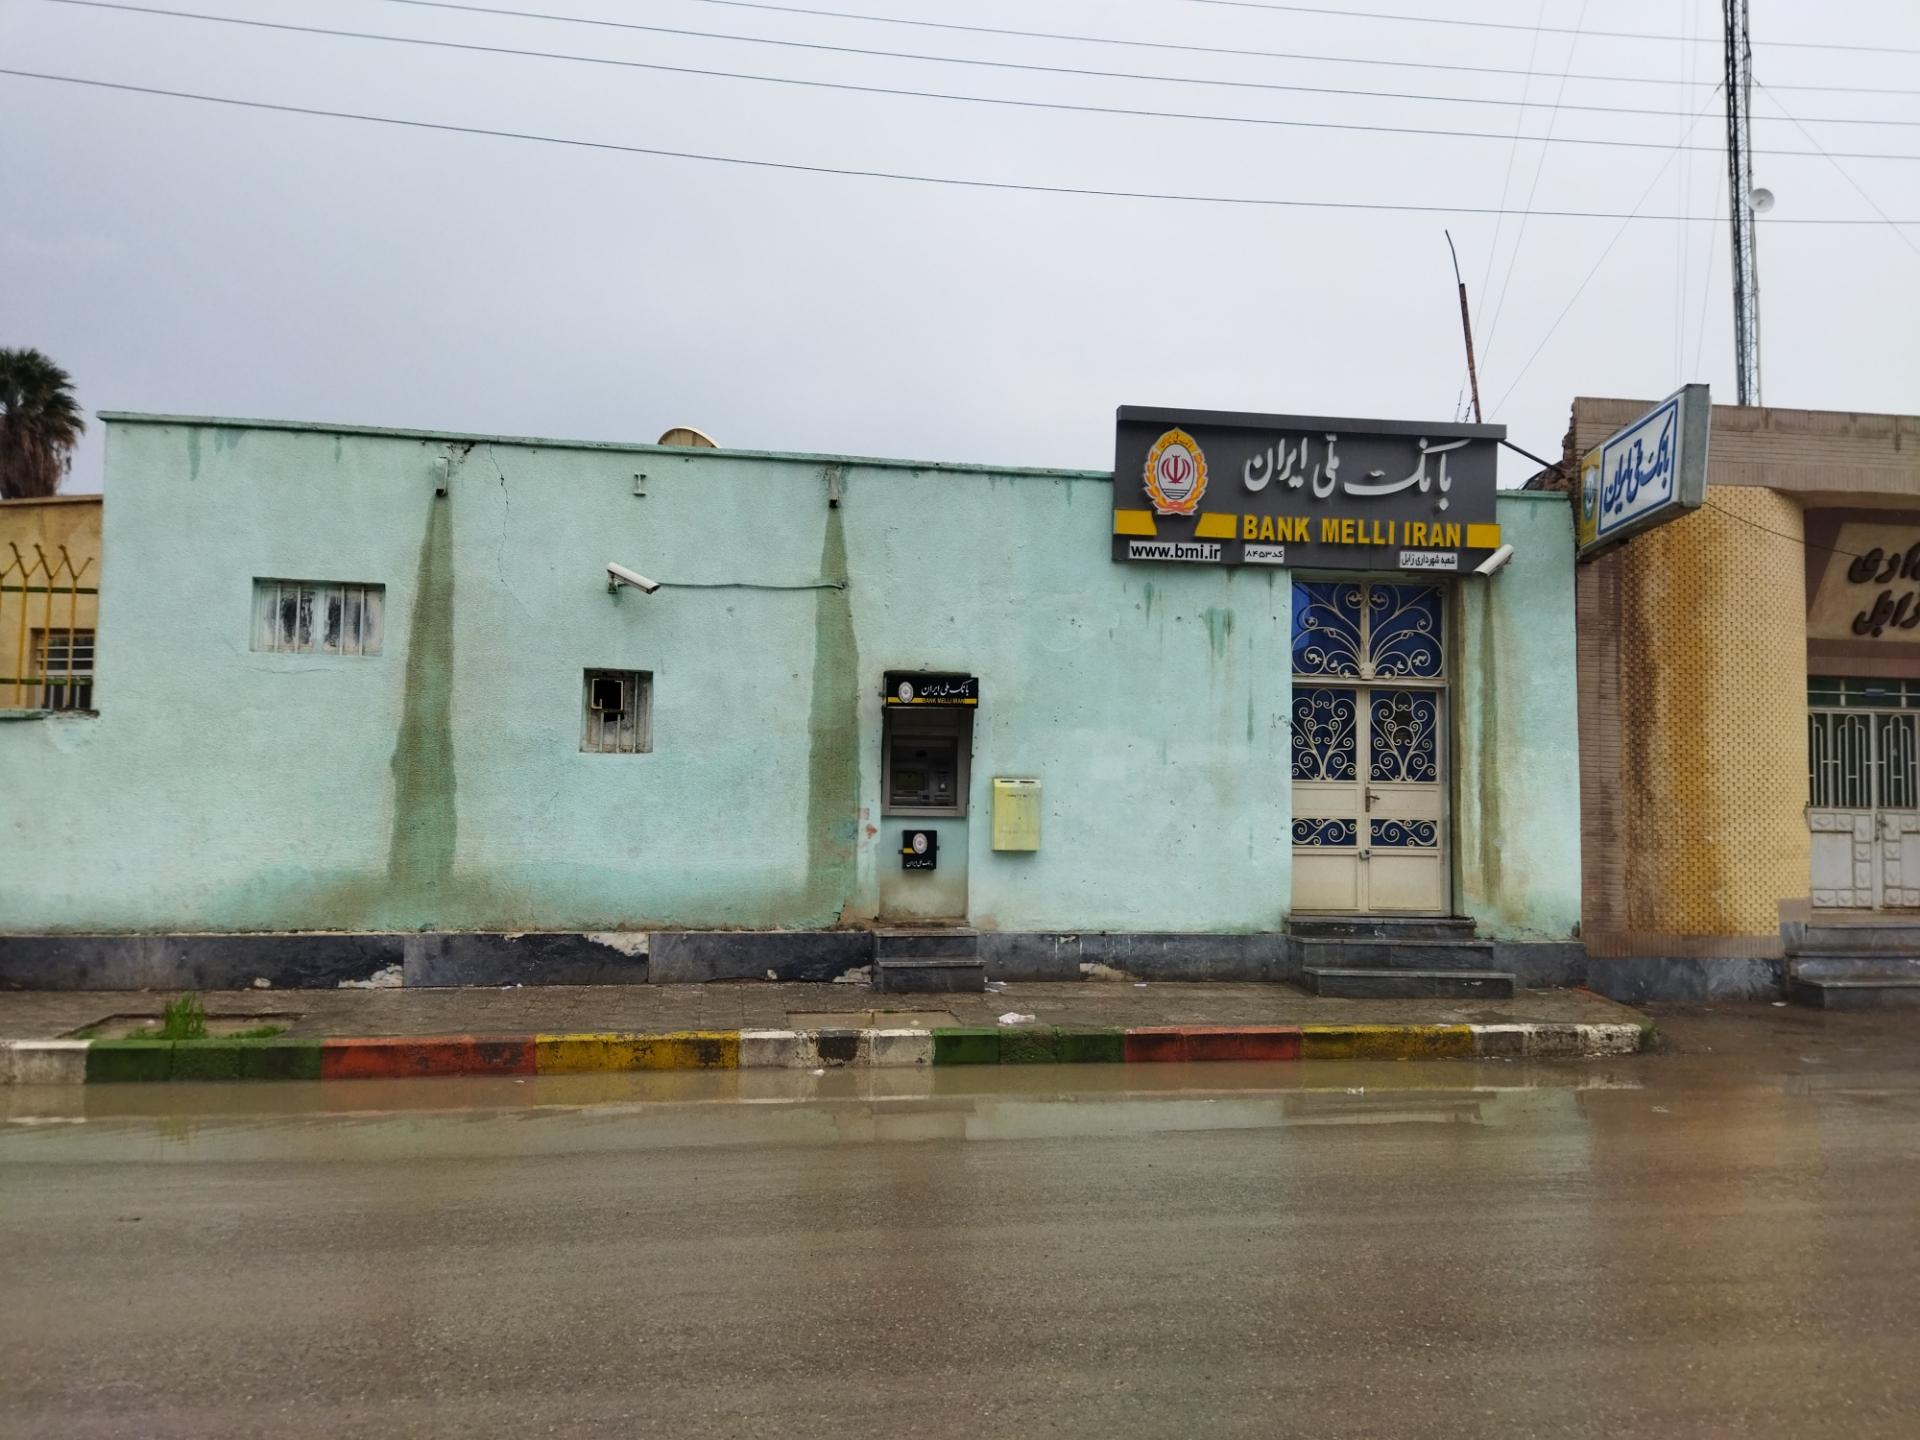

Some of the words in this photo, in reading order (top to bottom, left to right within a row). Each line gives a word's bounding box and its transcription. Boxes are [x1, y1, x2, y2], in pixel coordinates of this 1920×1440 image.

[1640, 410, 1674, 488] بانک
[1243, 437, 1308, 492] ایران
[1344, 437, 1472, 512] بانک
[1603, 447, 1633, 515] ایران
[1243, 514, 1310, 543] BANK
[1321, 518, 1396, 546] MELLI
[1403, 521, 1462, 548] IRAN
[1130, 543, 1222, 560] www.bmi.ir
[1415, 553, 1440, 567] شهرداری
[1440, 554, 1456, 568] شعبه
[921, 684, 940, 696] ایران
[949, 679, 975, 696] بانک
